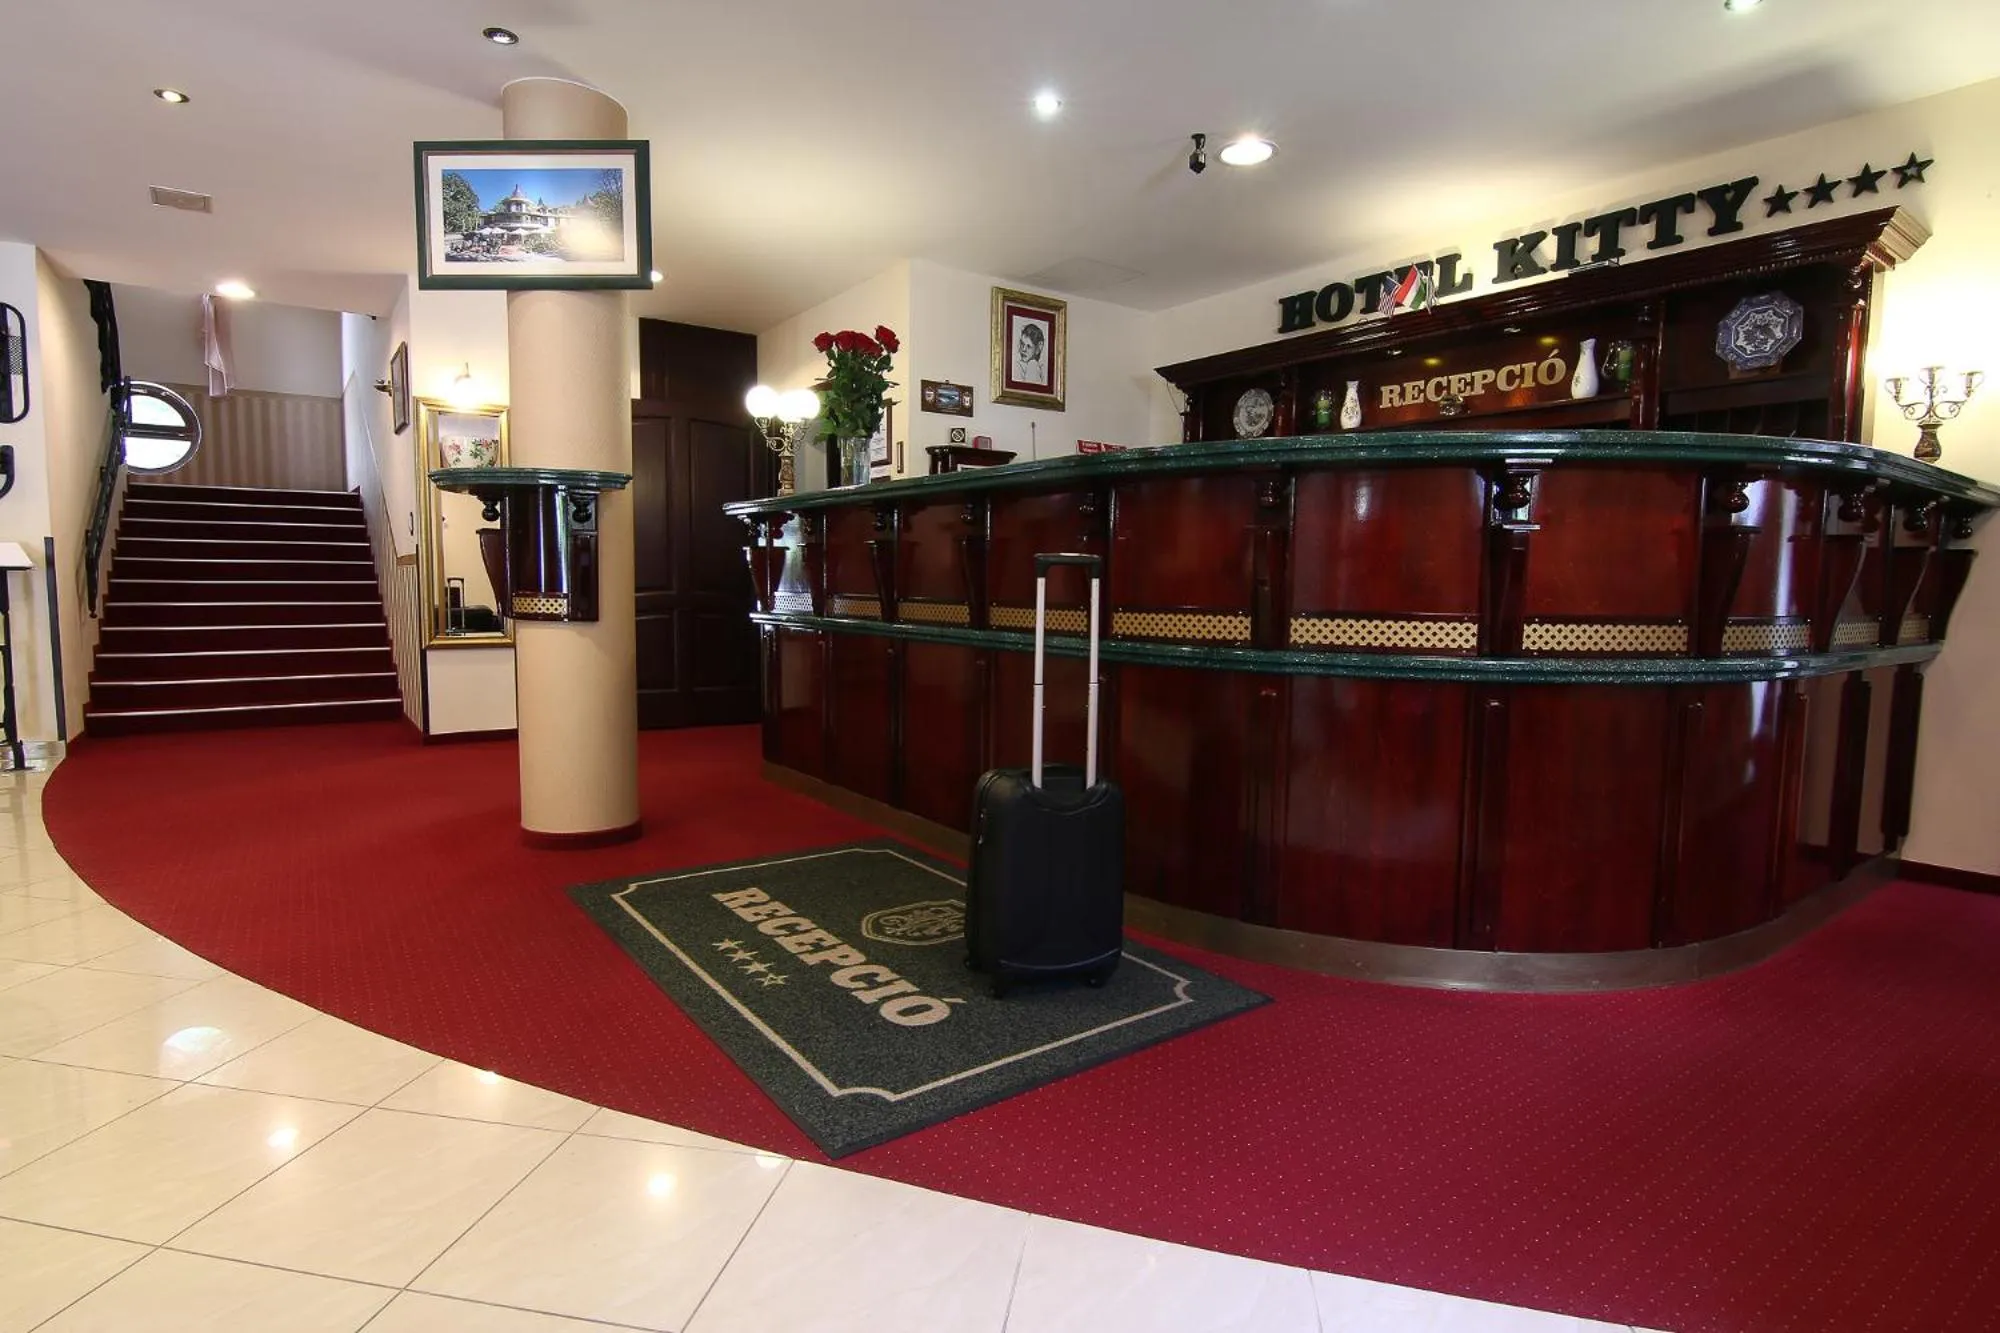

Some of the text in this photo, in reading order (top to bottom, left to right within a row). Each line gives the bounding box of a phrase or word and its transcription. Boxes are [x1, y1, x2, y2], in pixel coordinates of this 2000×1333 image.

[1491, 176, 1759, 284] KITTY
[1379, 348, 1567, 409] RECEPCIÓ
[711, 887, 967, 1026] RECEPCIÓ
